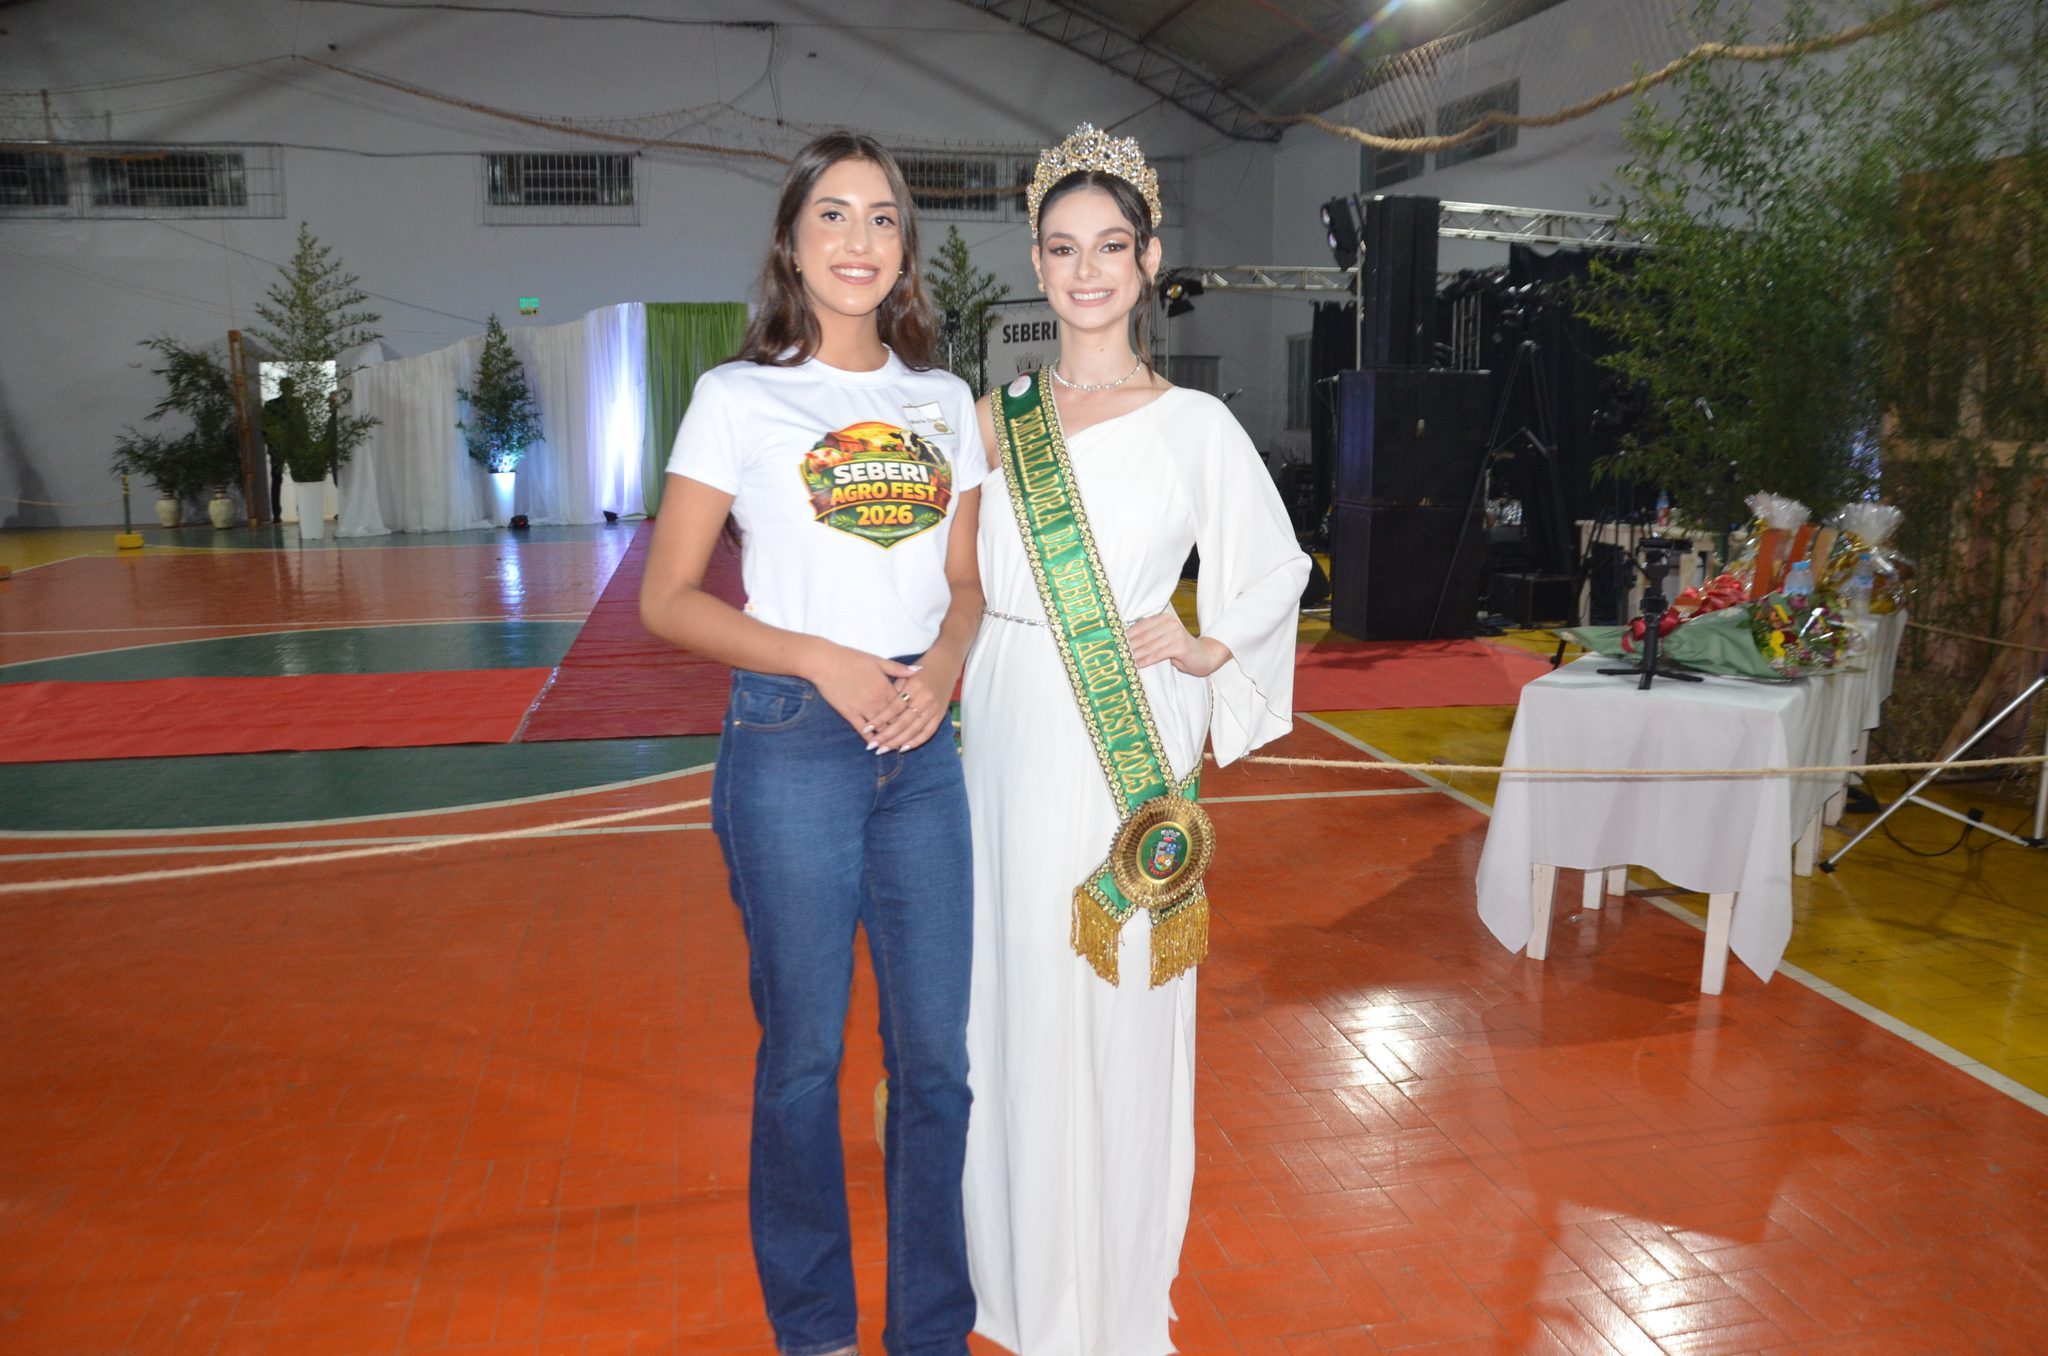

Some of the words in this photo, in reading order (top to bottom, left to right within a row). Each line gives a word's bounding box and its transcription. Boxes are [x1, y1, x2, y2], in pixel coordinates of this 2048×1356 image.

[1003, 321, 1057, 344] SEBERI
[833, 462, 930, 485] SEBERI
[1010, 405, 1070, 529] EMBAIXADORA
[830, 481, 889, 506] AGRO
[890, 482, 938, 501] FEST
[856, 504, 914, 526] 2026
[1040, 525, 1079, 560] DA
[1051, 559, 1105, 637] SEBERI
[1075, 639, 1123, 693] AGRO
[1094, 689, 1140, 743] FEST
[1113, 741, 1161, 795] 2025
